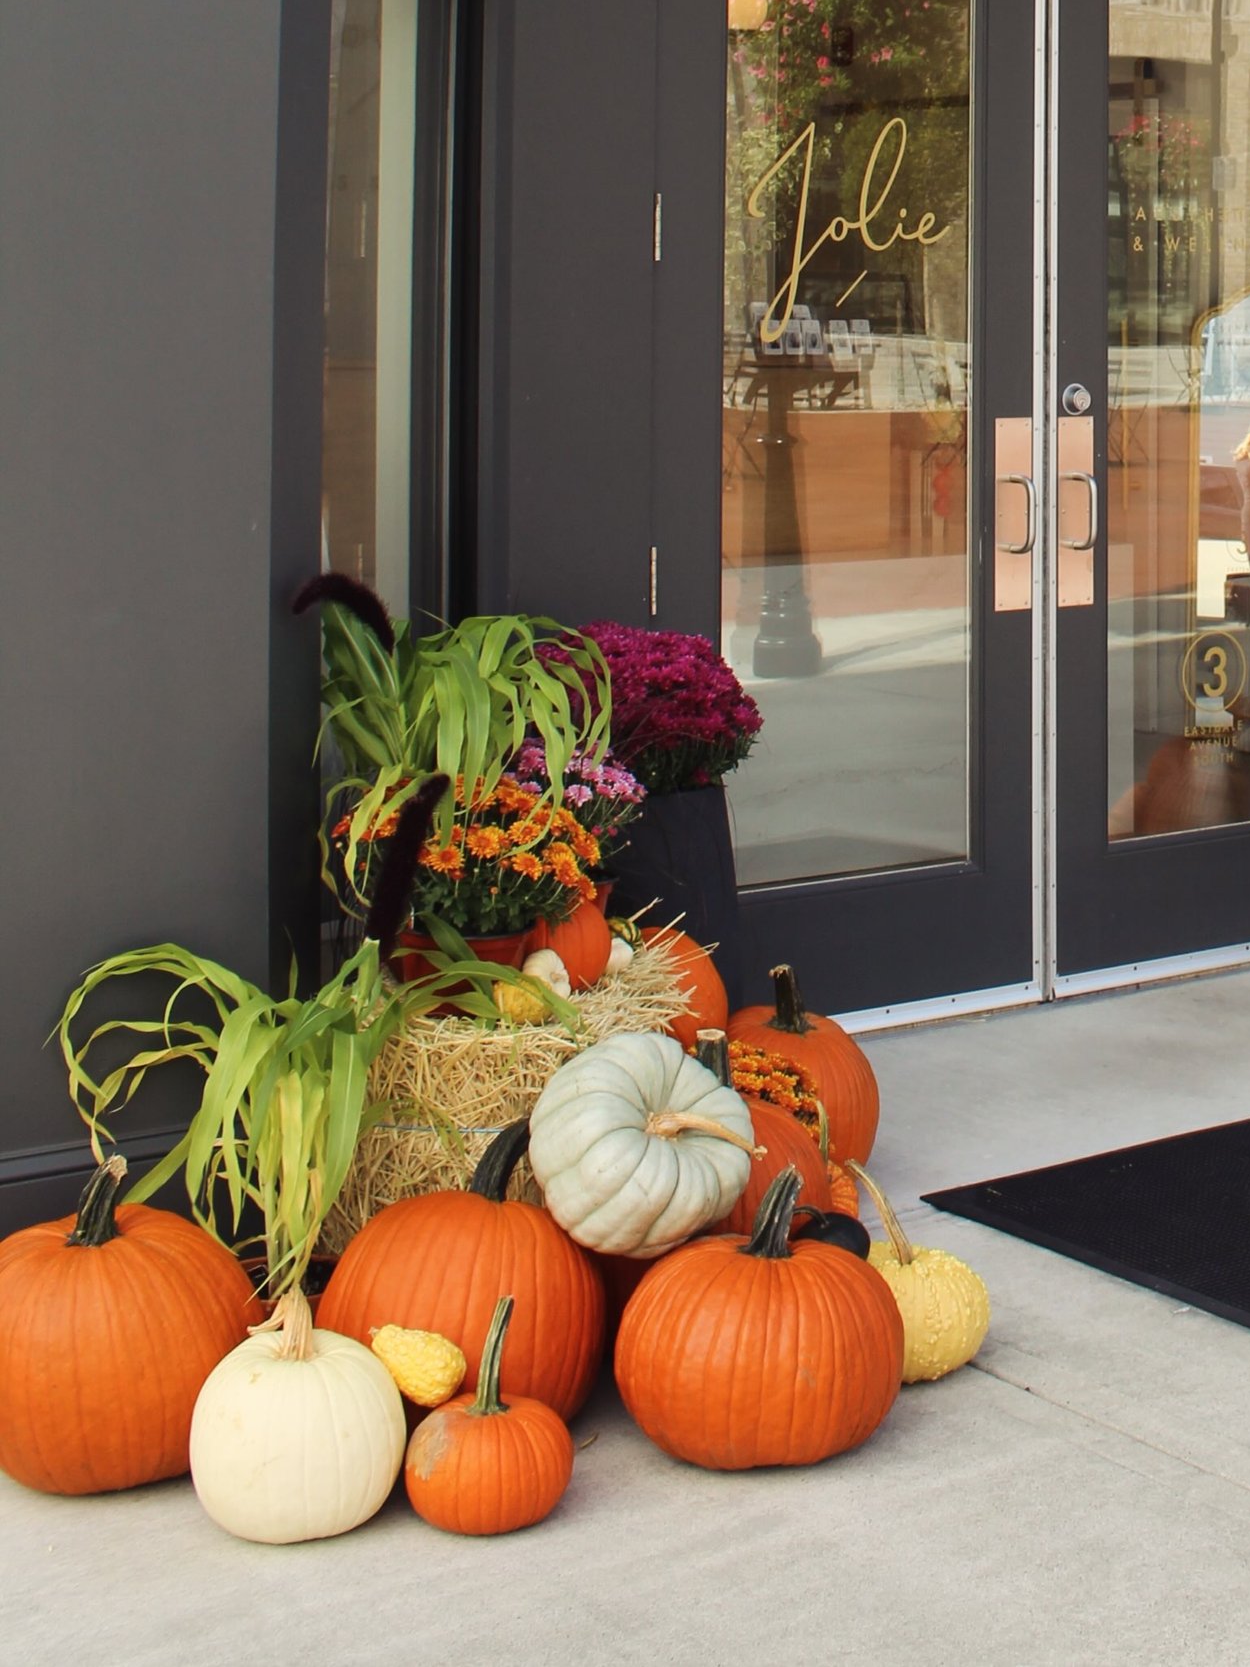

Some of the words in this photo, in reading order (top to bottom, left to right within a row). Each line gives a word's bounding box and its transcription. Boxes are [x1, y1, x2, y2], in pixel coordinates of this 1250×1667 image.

[747, 117, 951, 344] Jolie
[1133, 236, 1144, 252] &
[1202, 646, 1228, 697] 3
